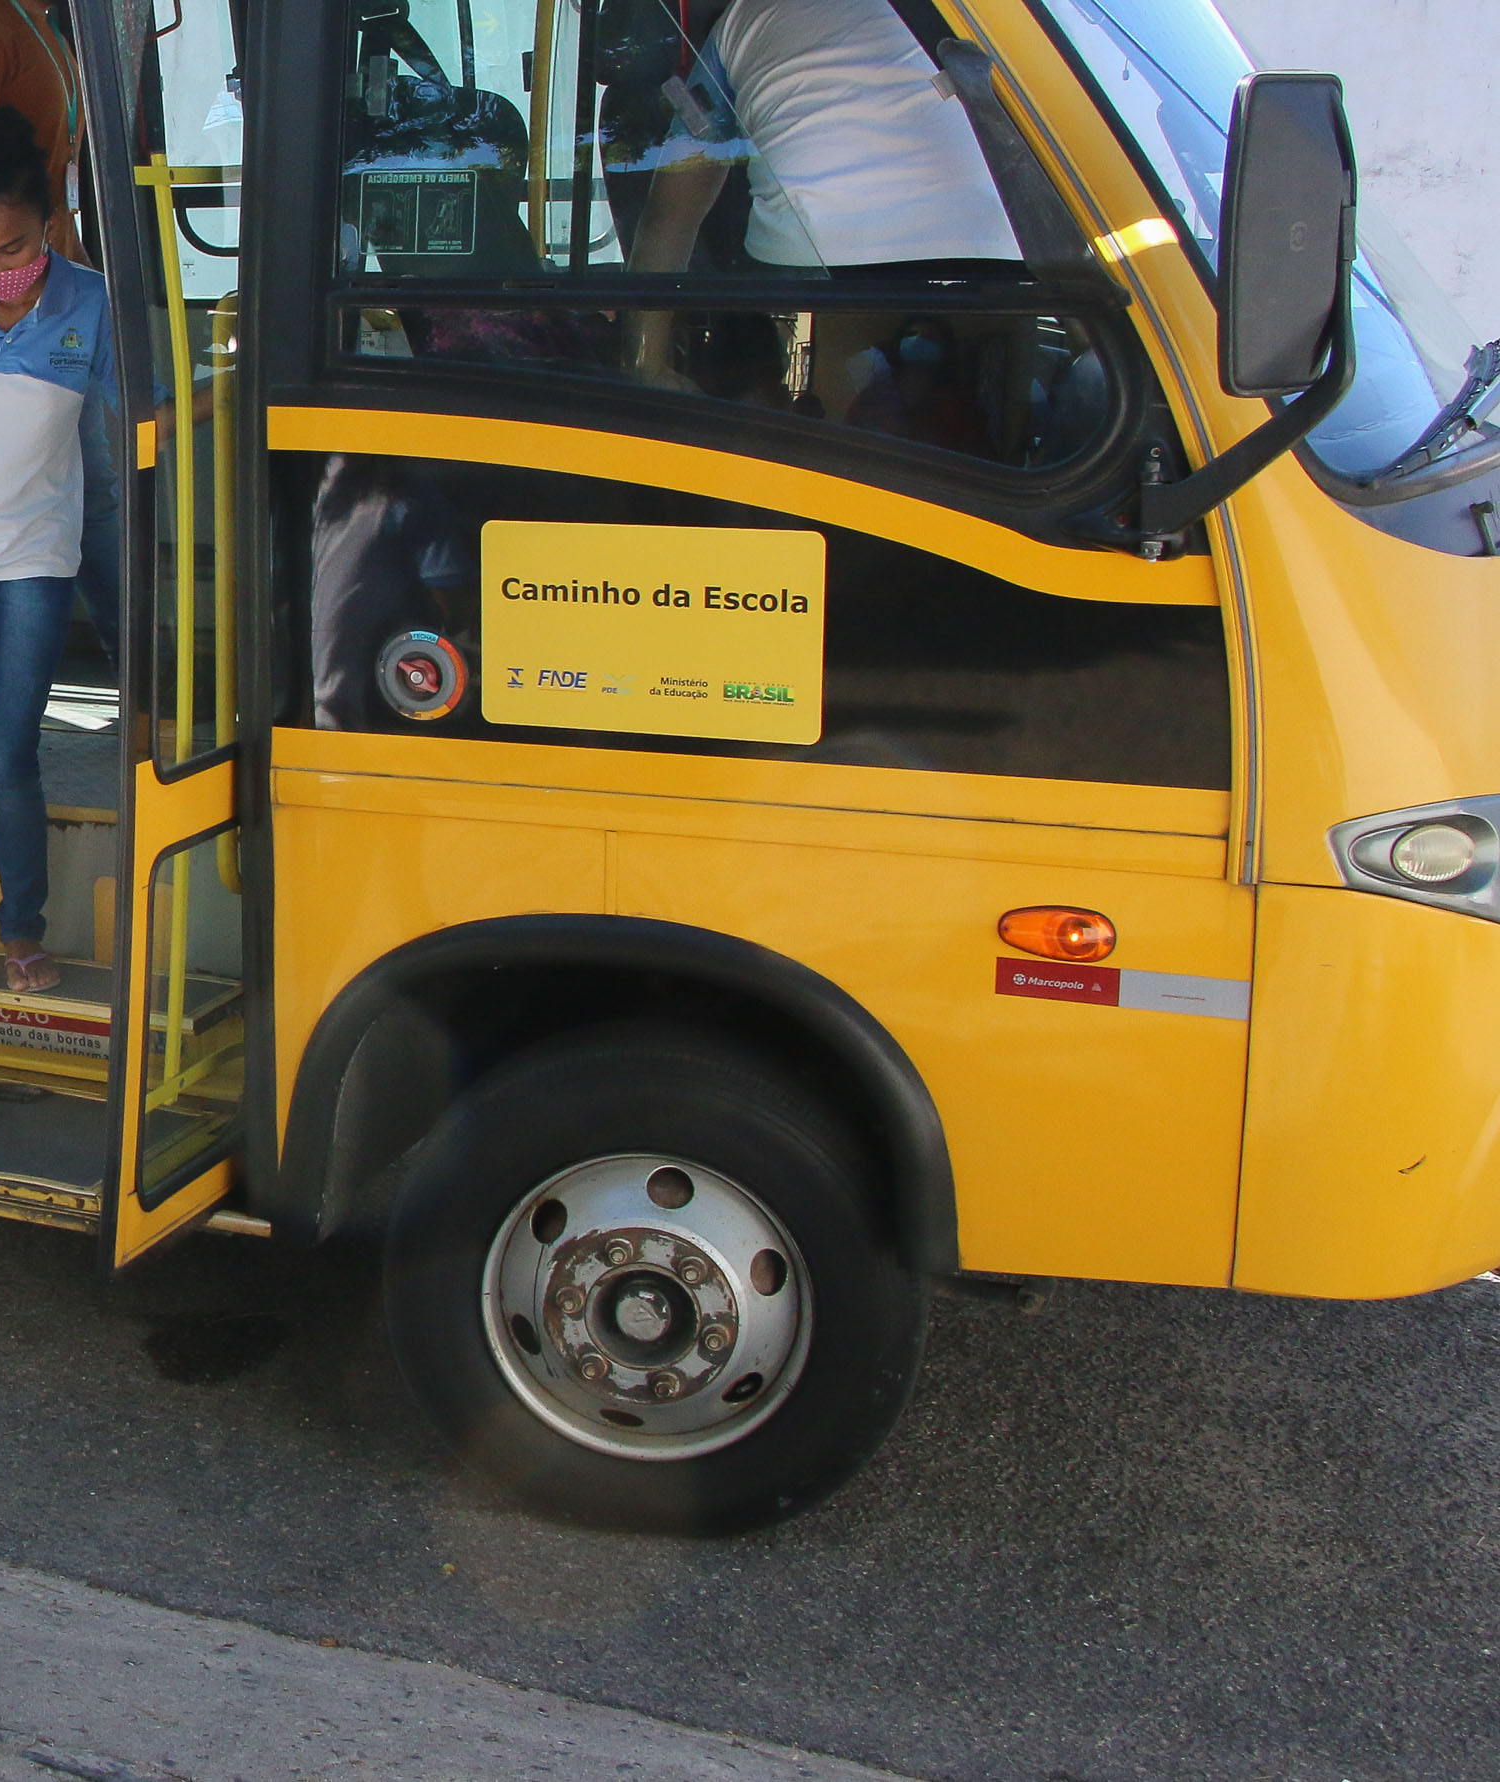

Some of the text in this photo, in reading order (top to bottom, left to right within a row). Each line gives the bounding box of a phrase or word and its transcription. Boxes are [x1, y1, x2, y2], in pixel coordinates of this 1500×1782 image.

[501, 577, 809, 614] Caminho da Escola
[537, 669, 588, 689] FNDE
[660, 677, 708, 688] Ministério
[649, 687, 708, 700] da Educação
[723, 683, 794, 703] BRASIL
[1027, 976, 1084, 991] Marcopolo
[28, 1028, 50, 1042] das
[57, 1032, 101, 1049] bordas
